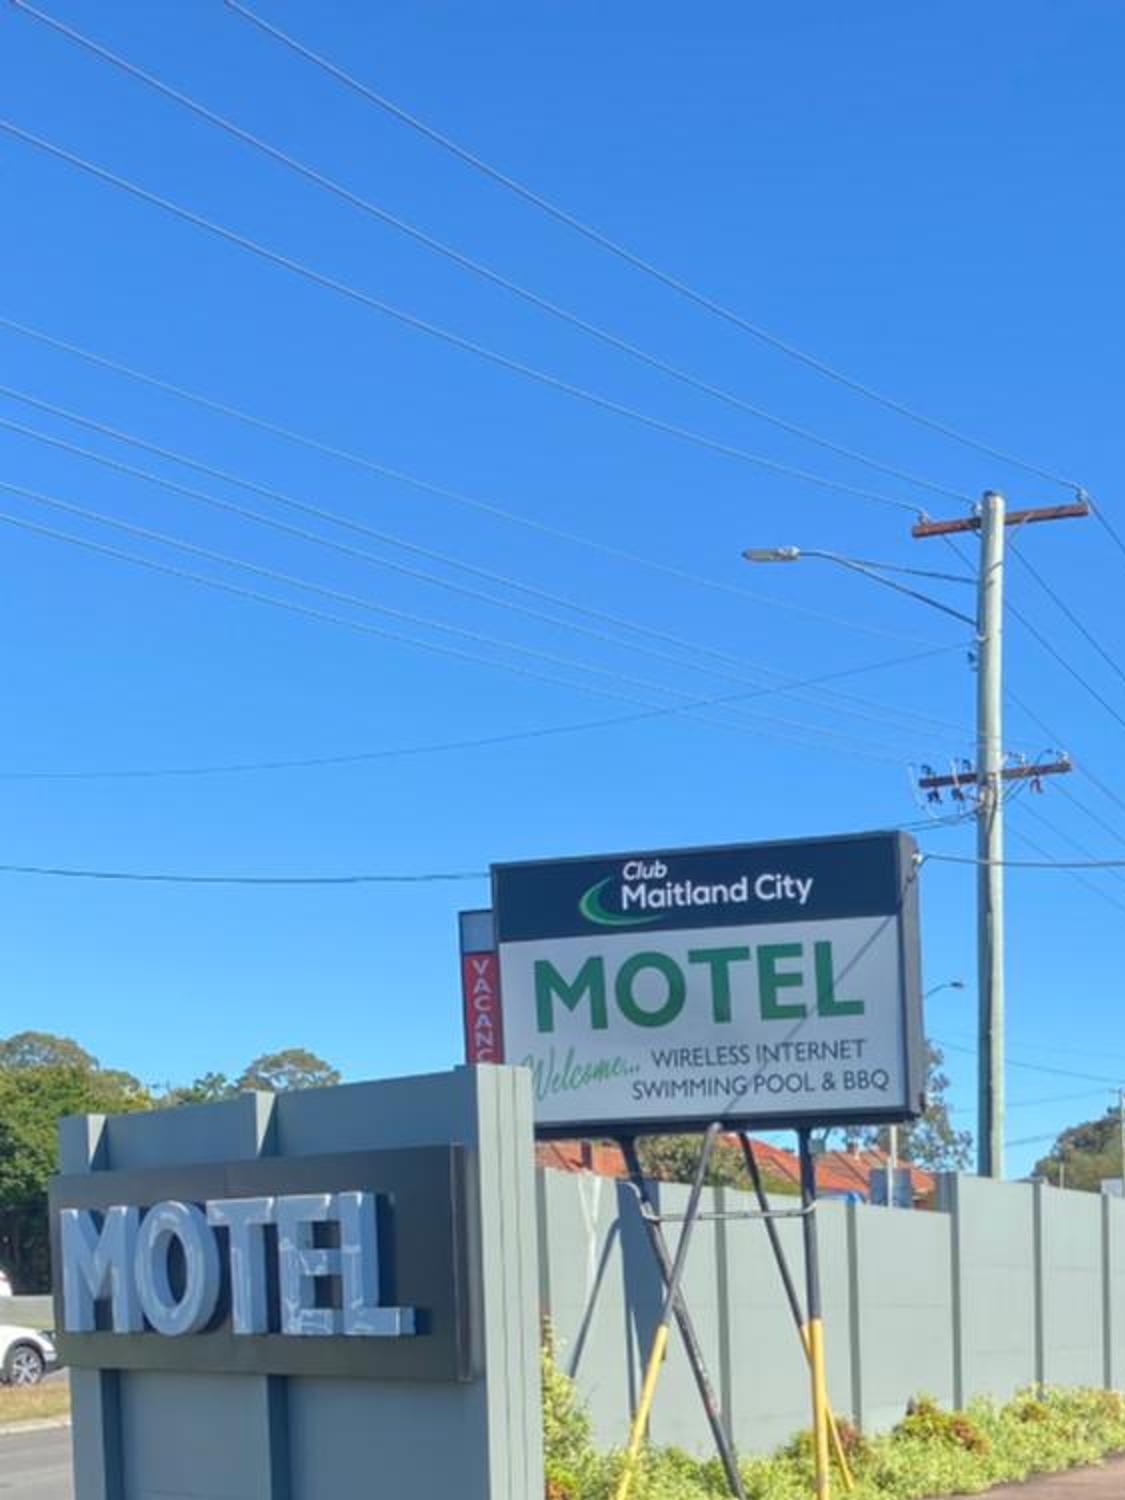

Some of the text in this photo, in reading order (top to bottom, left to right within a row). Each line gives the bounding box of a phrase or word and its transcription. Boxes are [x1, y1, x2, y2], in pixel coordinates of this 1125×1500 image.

[622, 860, 668, 880] Club
[621, 873, 814, 910] Maitland City
[533, 940, 865, 1034] MOTEL
[651, 1038, 867, 1069] WIRELESS INTERNET
[632, 1068, 890, 1101] SWIMMING POOL & BBQ
[60, 1190, 416, 1336] MOTEL
